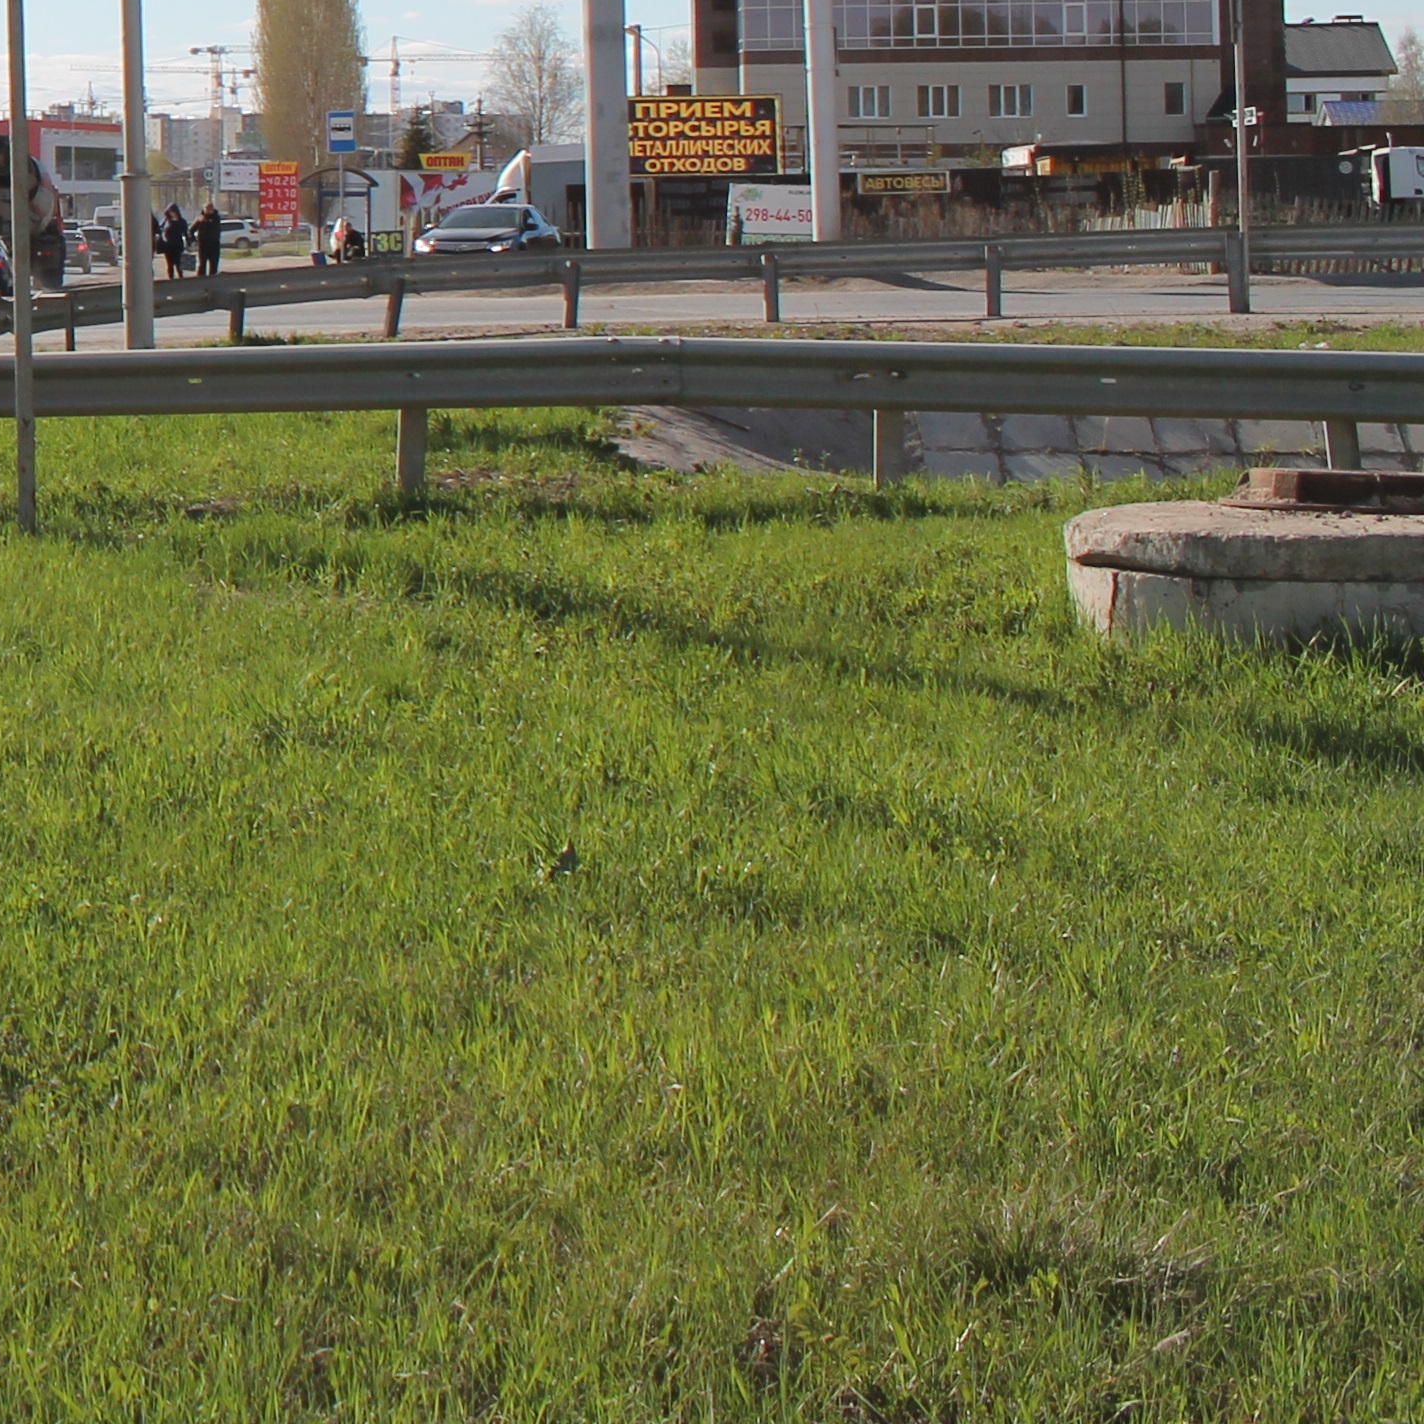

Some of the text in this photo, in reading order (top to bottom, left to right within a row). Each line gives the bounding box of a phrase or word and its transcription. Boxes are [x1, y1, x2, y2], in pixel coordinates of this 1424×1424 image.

[634, 101, 752, 119] ПРИЕМ
[426, 156, 465, 167] ОПТАН
[644, 157, 747, 174] ОТХОДОВ
[864, 176, 945, 190] АВТОВЕСЫ
[745, 208, 812, 223] 298-44-50
